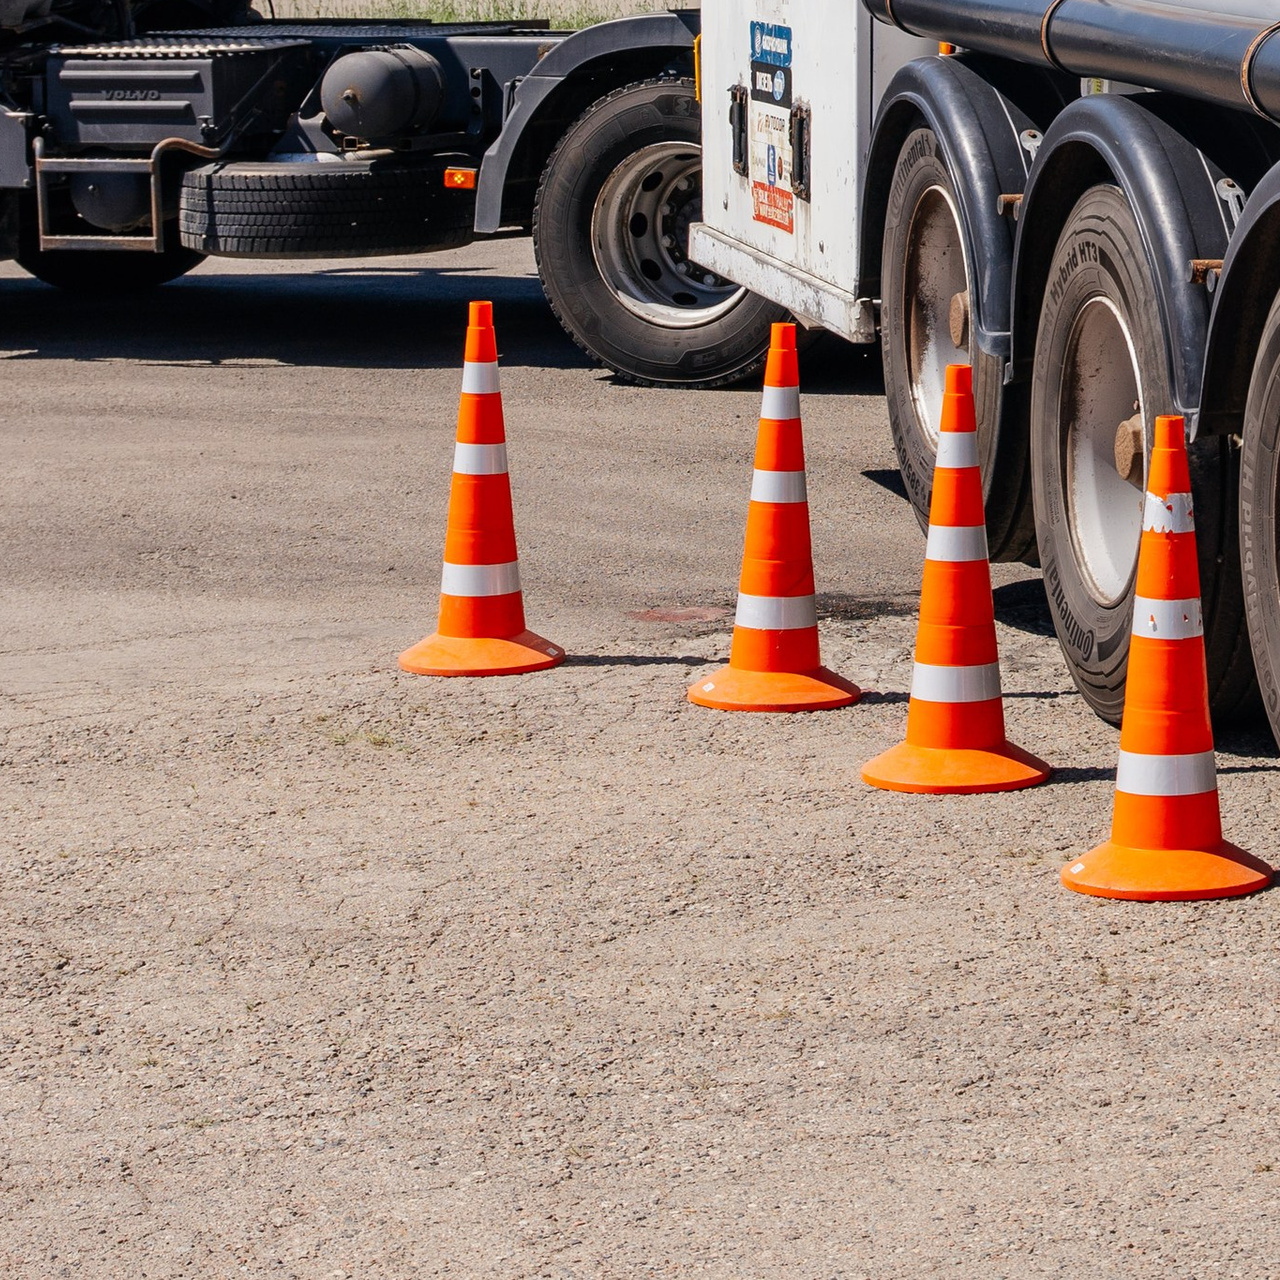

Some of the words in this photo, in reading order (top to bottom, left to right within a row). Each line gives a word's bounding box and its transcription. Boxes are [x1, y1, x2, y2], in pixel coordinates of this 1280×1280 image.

[101, 89, 160, 101] VOLVO
[1050, 246, 1078, 307] Hybrid
[1078, 240, 1098, 264] HT3
[897, 435, 921, 497] 385/65
[1242, 500, 1258, 620] Hybrid
[1044, 556, 1095, 663] Continental
